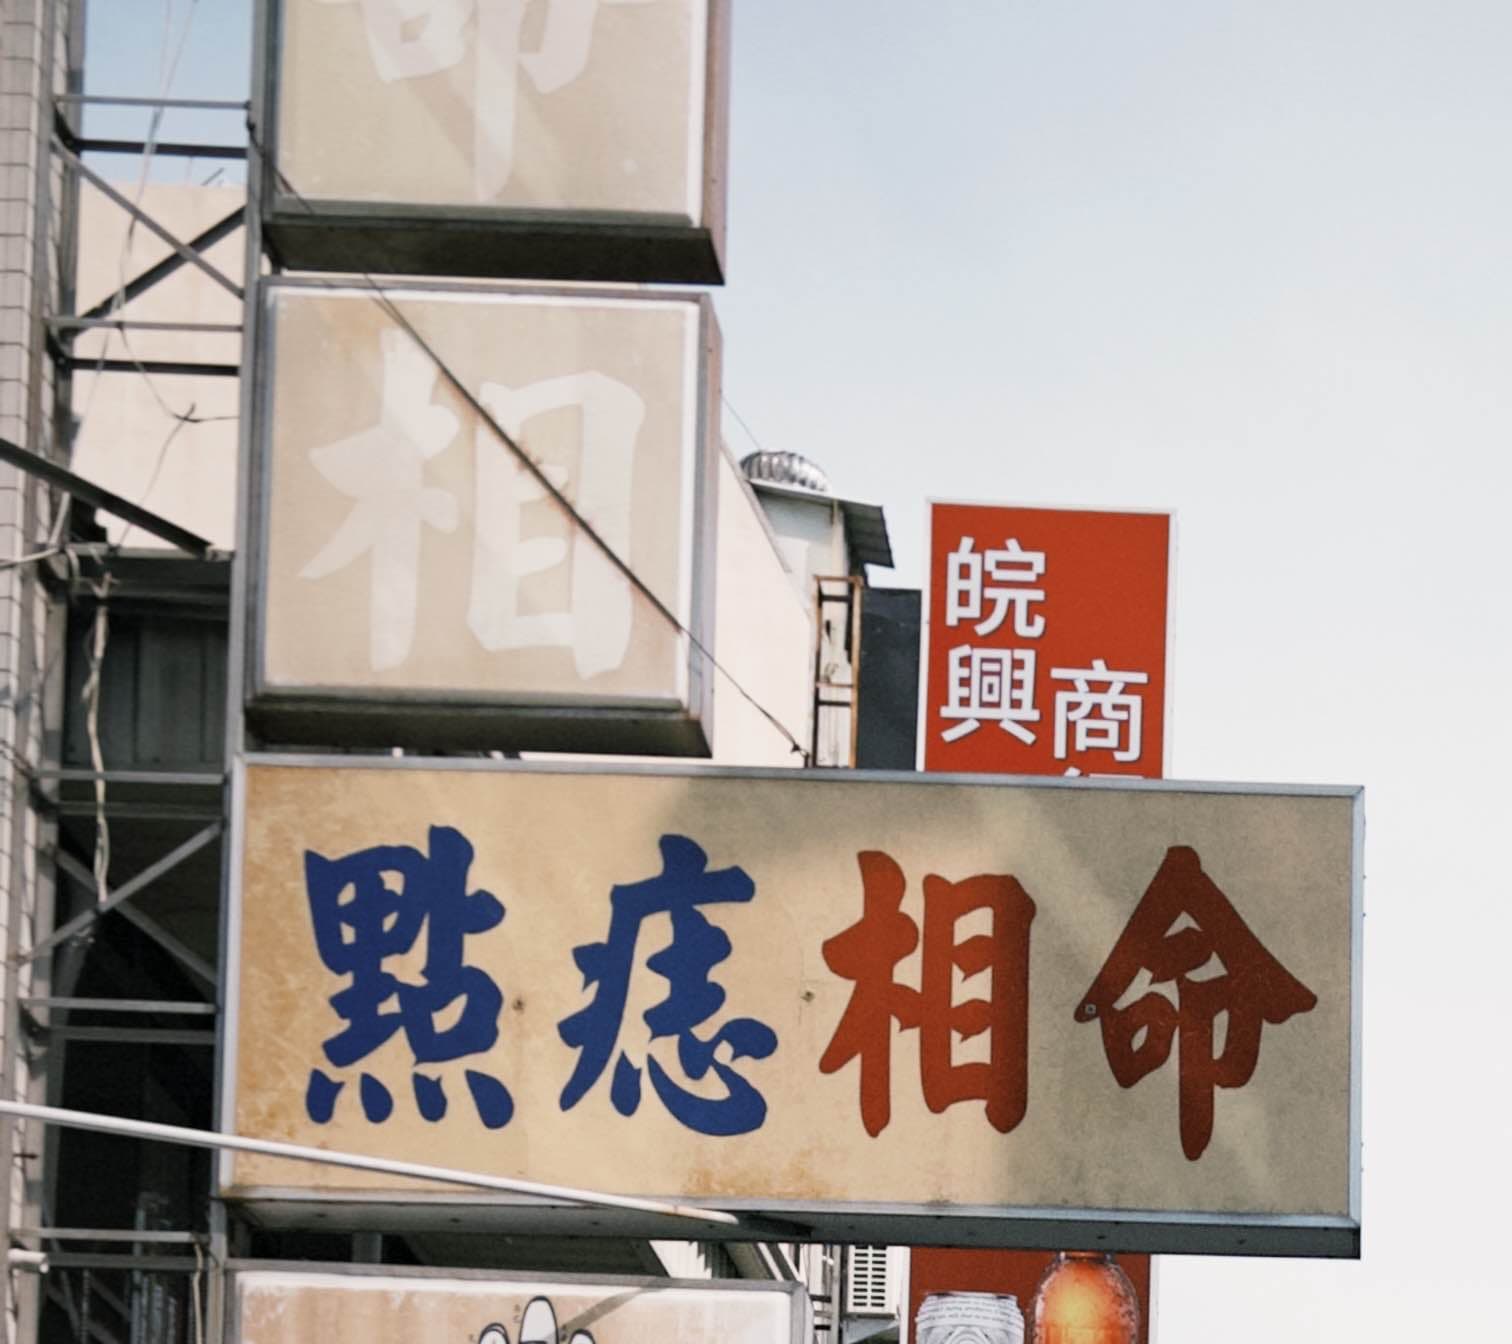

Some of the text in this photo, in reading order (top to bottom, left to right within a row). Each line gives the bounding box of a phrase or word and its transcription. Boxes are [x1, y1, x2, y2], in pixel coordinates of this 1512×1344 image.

[299, 324, 645, 680] 相
[940, 536, 1046, 746] 皖興
[1050, 659, 1149, 780] 商
